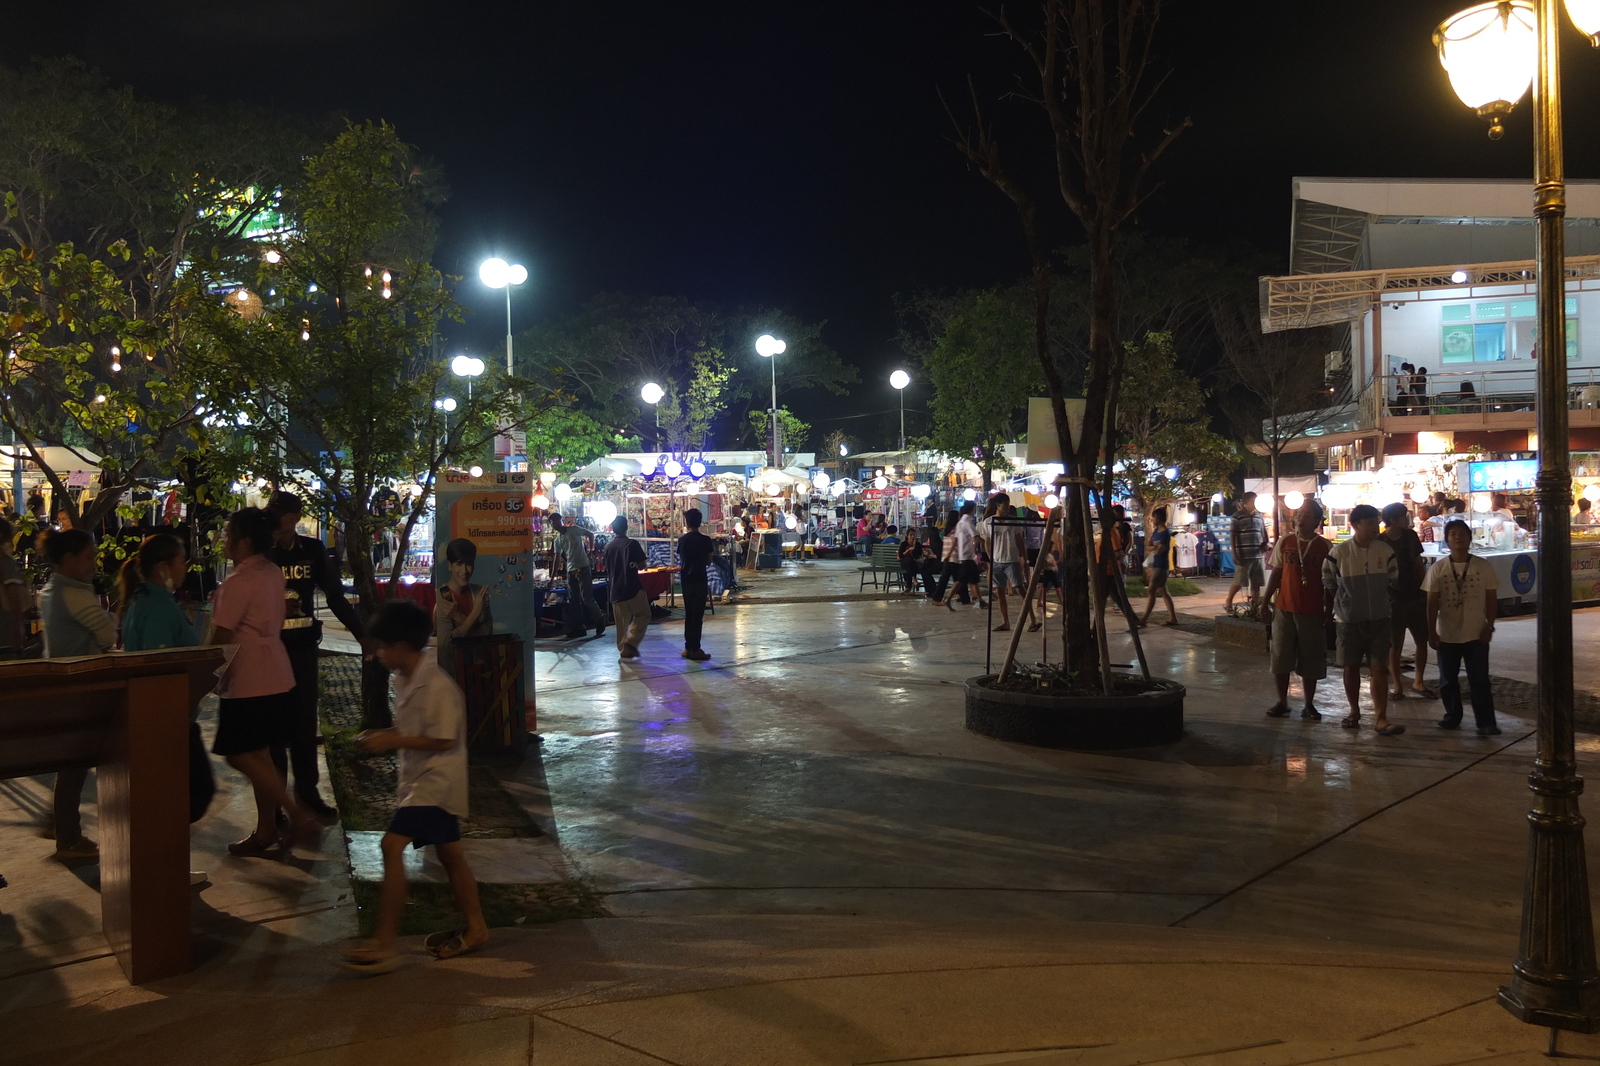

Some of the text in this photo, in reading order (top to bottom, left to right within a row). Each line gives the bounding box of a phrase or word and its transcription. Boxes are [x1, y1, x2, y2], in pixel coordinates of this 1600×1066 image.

[472, 497, 524, 511] เครื่อง 3G+
[497, 515, 516, 526] 990
